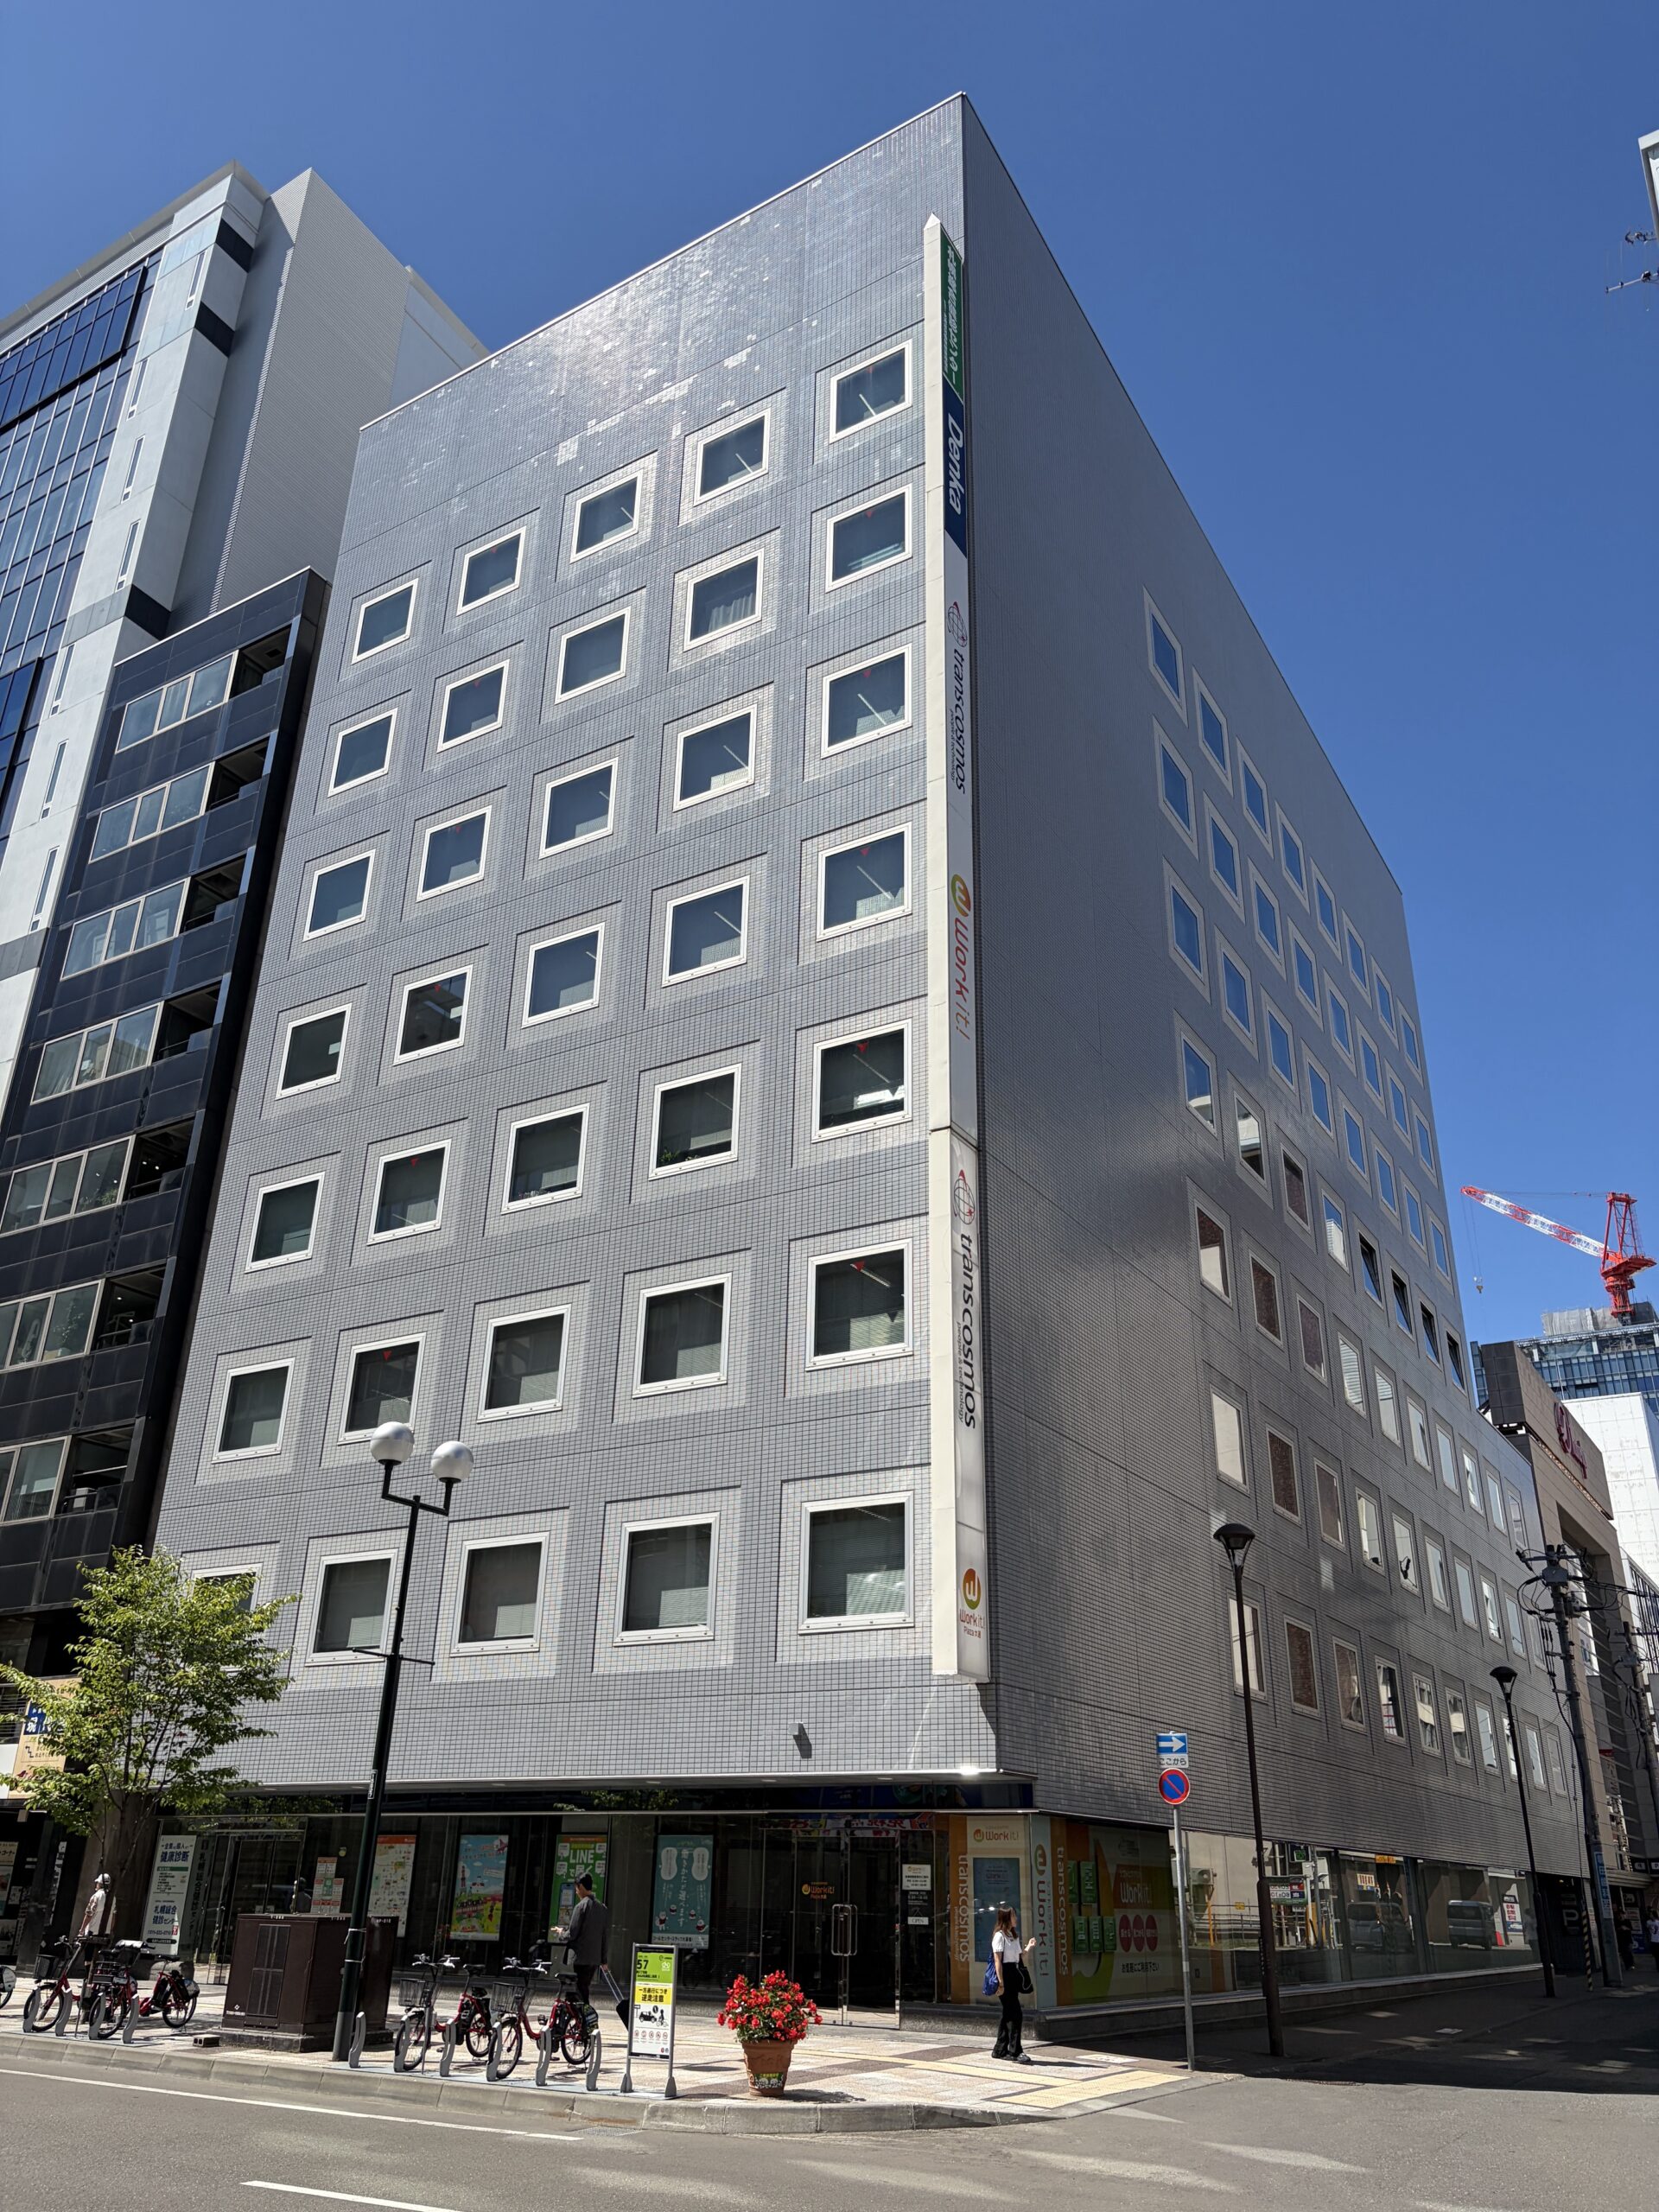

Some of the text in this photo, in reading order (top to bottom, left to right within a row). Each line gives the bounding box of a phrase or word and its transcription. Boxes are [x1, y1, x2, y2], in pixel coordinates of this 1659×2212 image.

[948, 413, 963, 516] Denka
[953, 648, 965, 795] transcosmos
[960, 1233, 976, 1429] transcosmos
[1159, 1758, 1187, 1766] ここから
[160, 1851, 190, 1862] 健康診断
[569, 1849, 594, 1864] LINE
[154, 1904, 177, 1915] 札幌総合
[958, 1853, 969, 1962] transcosmos
[1057, 1847, 1069, 1976] transcosmos
[636, 1959, 650, 1970] 57
[639, 1986, 668, 1995] 一方通行につき
[641, 1994, 664, 2003] 逆走注意
